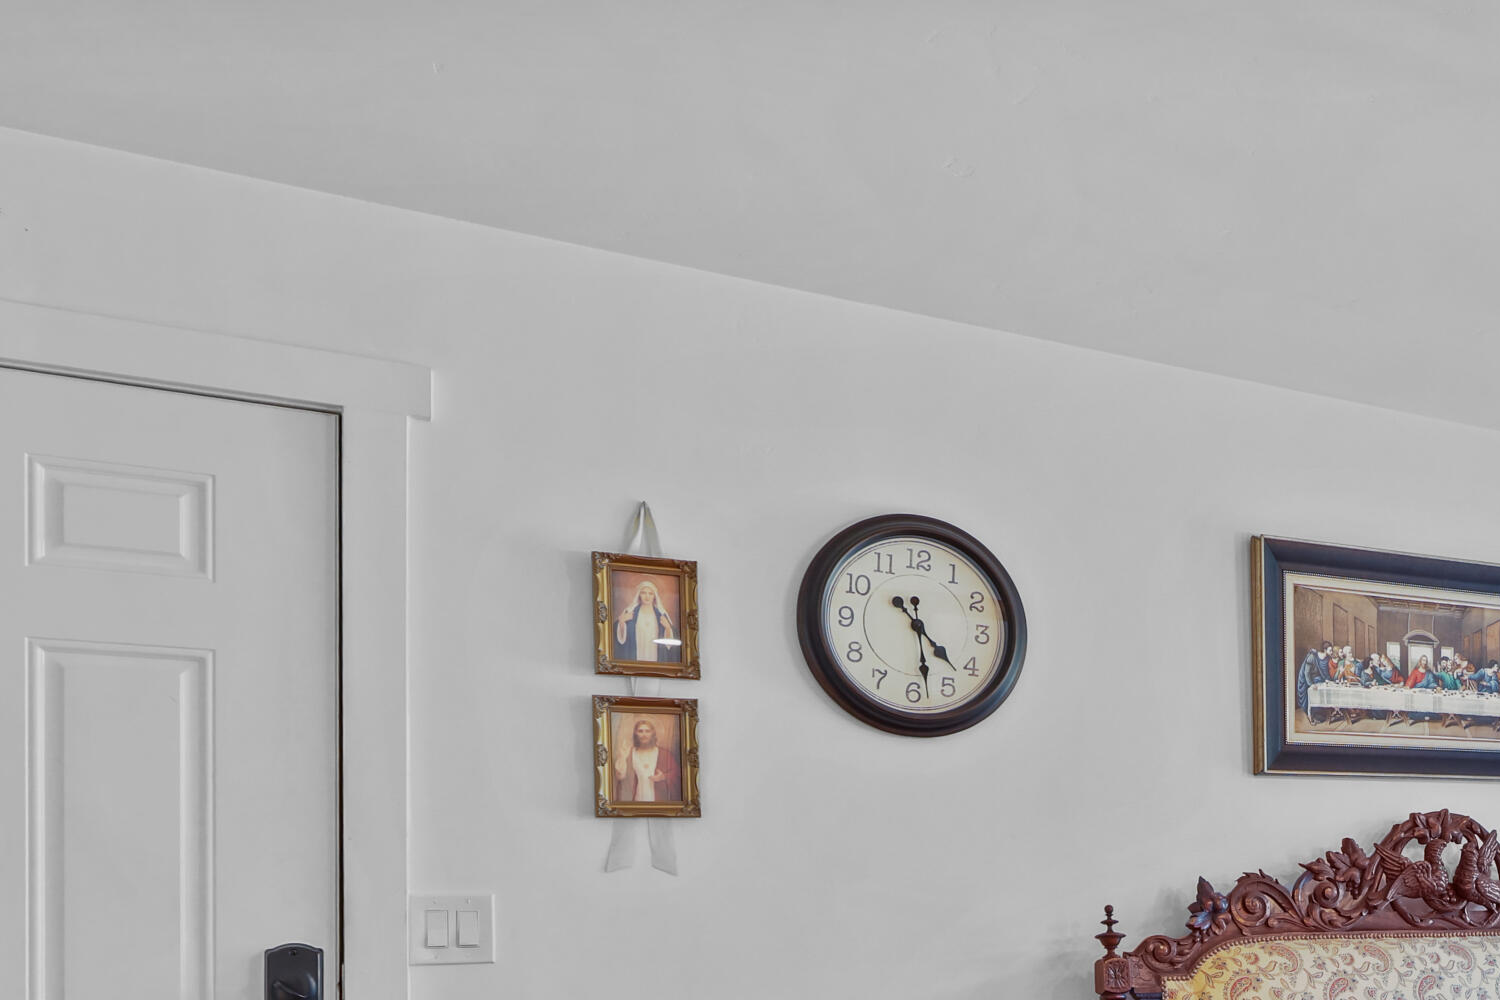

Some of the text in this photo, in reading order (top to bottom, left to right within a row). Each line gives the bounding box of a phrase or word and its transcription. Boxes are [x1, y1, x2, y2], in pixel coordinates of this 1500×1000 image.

[873, 552, 895, 574] 11
[906, 549, 931, 571] 12
[845, 573, 871, 595] 10
[948, 564, 958, 584] 1
[969, 592, 984, 612] 2
[838, 605, 854, 627] 9
[974, 624, 989, 644] 3
[847, 642, 862, 662] 8
[963, 657, 979, 677] 4
[872, 668, 887, 689] 7
[940, 677, 955, 697] 5
[906, 682, 921, 703] 6
